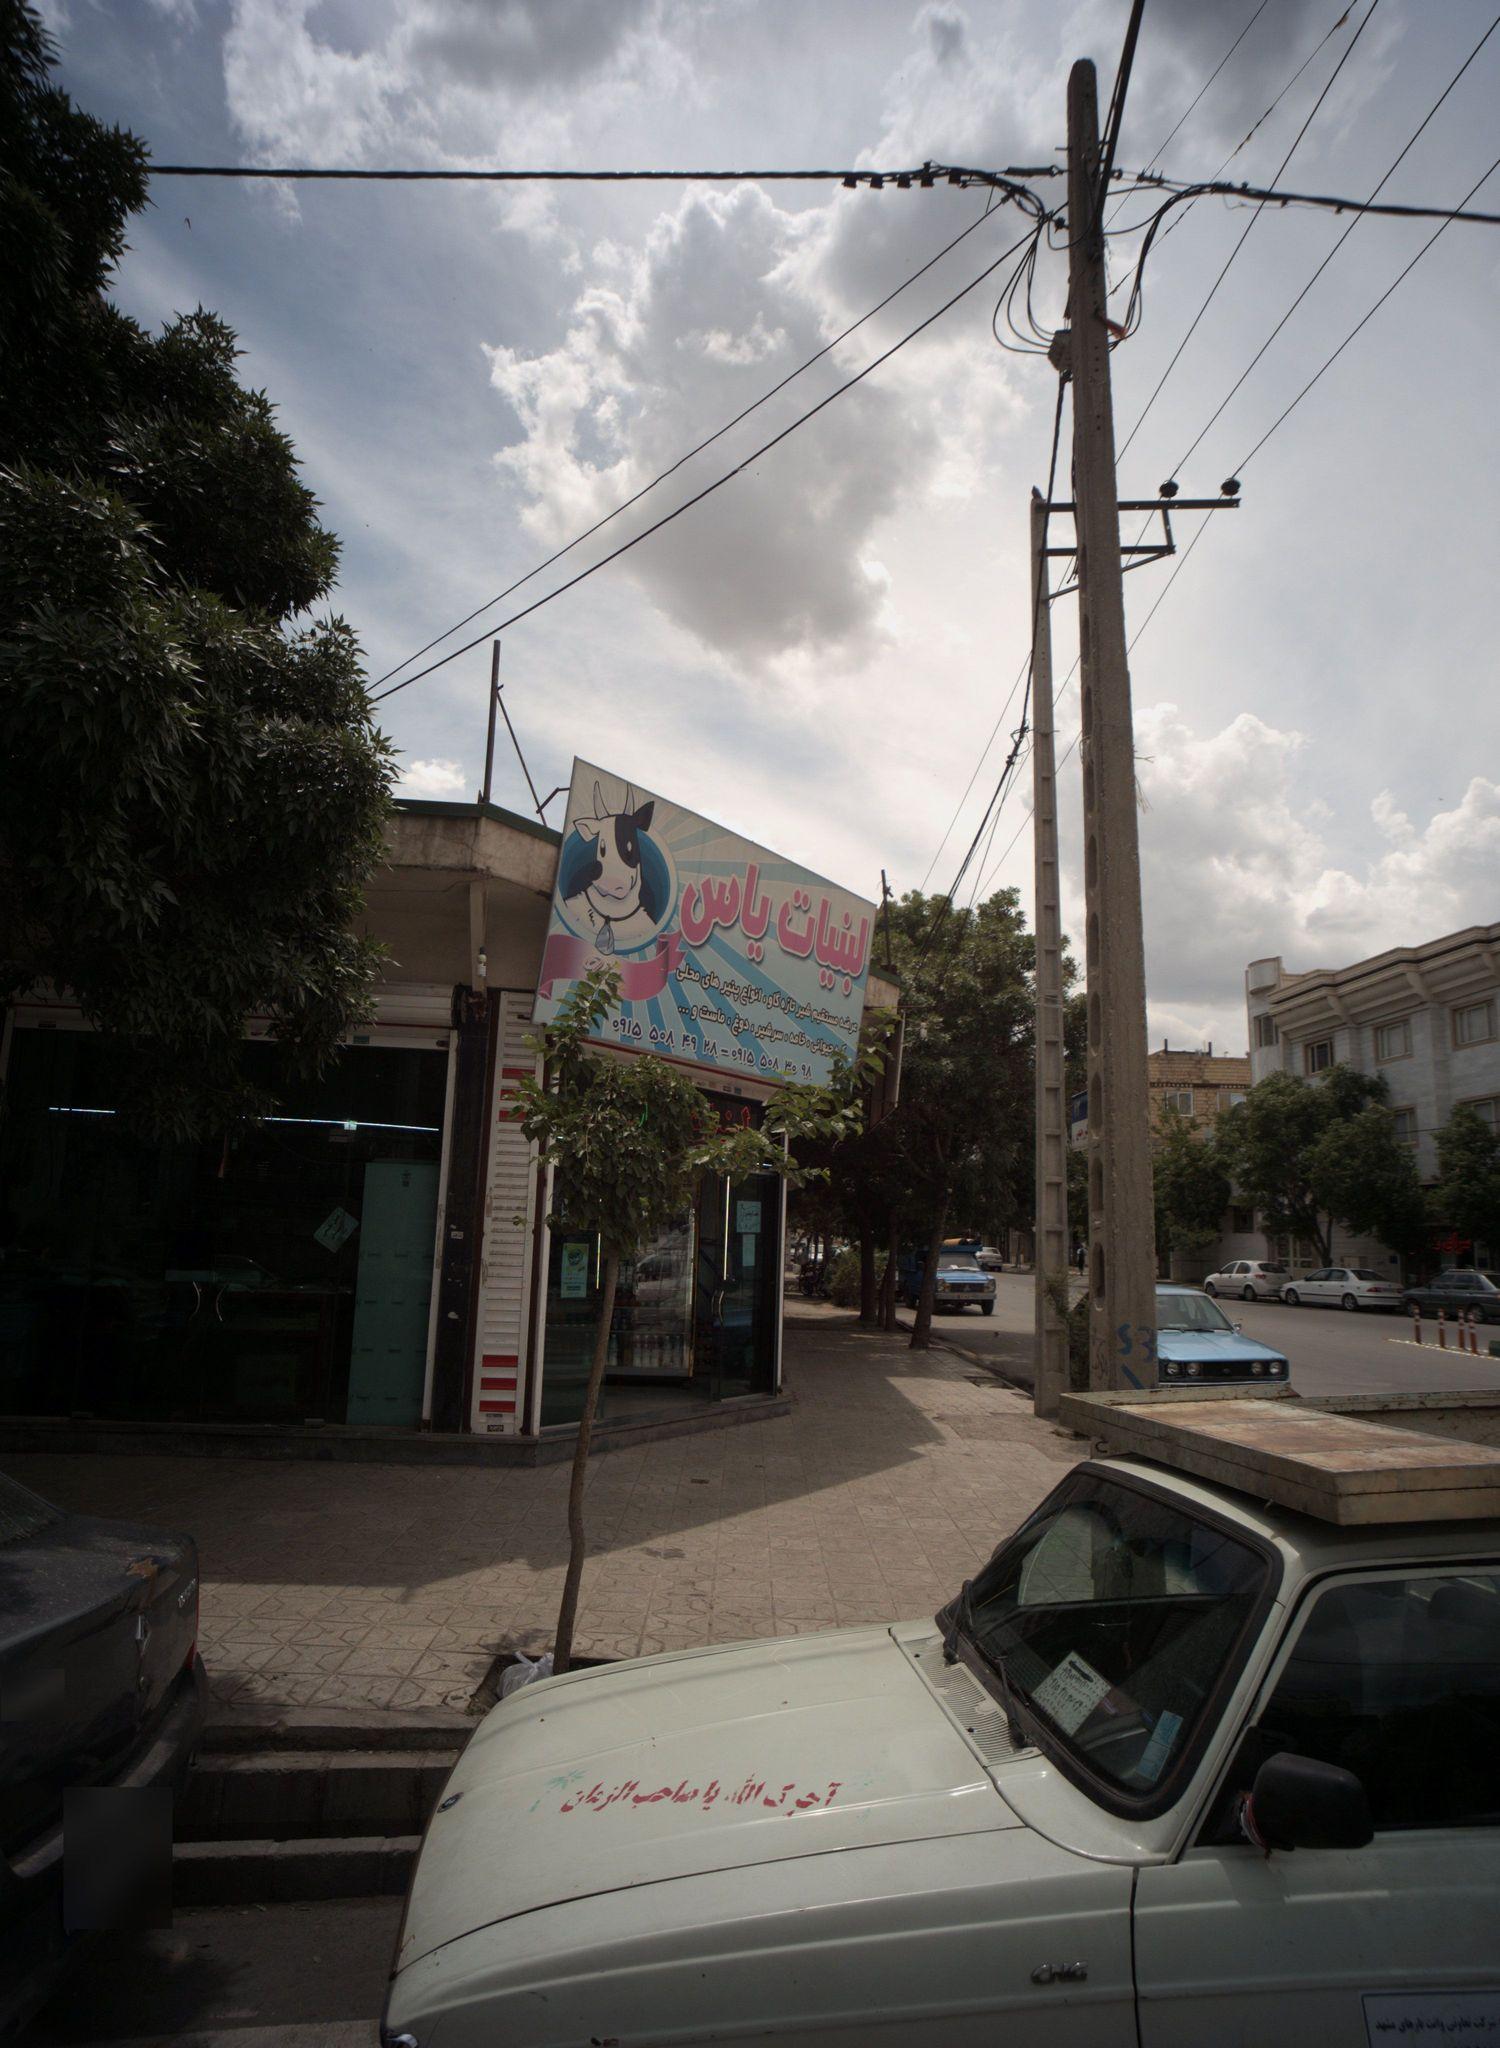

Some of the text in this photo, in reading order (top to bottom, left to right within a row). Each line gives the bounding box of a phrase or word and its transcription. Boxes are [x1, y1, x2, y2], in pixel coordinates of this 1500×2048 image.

[679, 862, 869, 997] لبنیات یاس
[676, 962, 701, 983] محلی
[701, 972, 721, 989] های
[720, 979, 741, 1002] پنیر
[740, 984, 762, 1005] انواع
[767, 991, 782, 1009] گاو
[690, 1004, 699, 1020] و
[699, 1004, 726, 1024] ماست
[781, 993, 797, 1014] تازه
[796, 1002, 812, 1019] شیر
[731, 1014, 749, 1037] دوغ
[811, 1006, 840, 1028] مستقیم
[839, 1015, 858, 1035] عرضه
[755, 1022, 784, 1043] سرشیر
[788, 1031, 806, 1048] خامه
[612, 1017, 642, 1038] ۰۹۱۵
[649, 1025, 674, 1046] ۵۰۸
[681, 1033, 697, 1051] ۴۹
[703, 1039, 718, 1056] ۲۸
[731, 1047, 755, 1065] ۰۹۱۵
[760, 1055, 779, 1070] ۵۰۸
[785, 1059, 797, 1072] ۳۰
[801, 1064, 812, 1078] ۹۸
[810, 1037, 834, 1055] حیوانی
